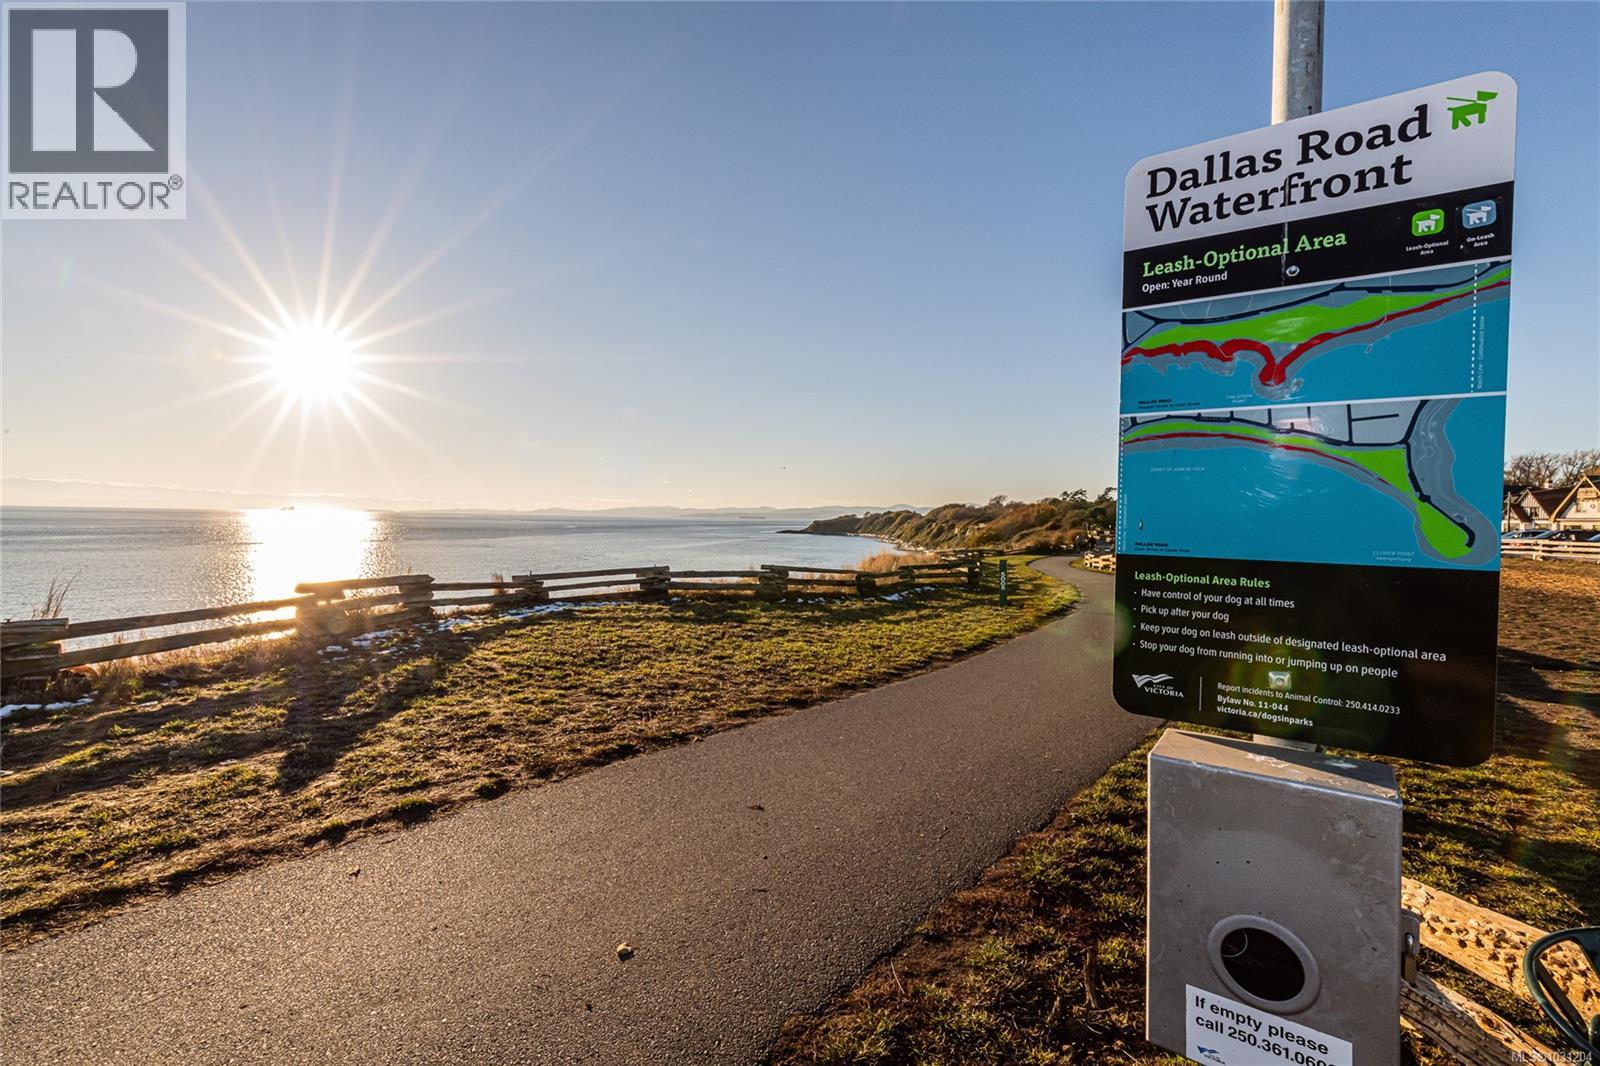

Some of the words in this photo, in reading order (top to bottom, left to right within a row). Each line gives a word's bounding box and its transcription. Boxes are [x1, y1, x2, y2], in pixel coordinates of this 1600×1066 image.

[1146, 147, 1282, 199] Dallas
[1297, 104, 1431, 166] Road
[1146, 154, 1413, 232] Waterfront
[1406, 240, 1449, 252] Leash-Optional
[1466, 232, 1495, 243] On-Leash
[1142, 238, 1289, 277] Leash-Optional
[1295, 231, 1348, 253] Area
[1142, 281, 1170, 294] Open:
[1172, 278, 1193, 288] Year
[1195, 271, 1228, 284] Round
[1134, 570, 1210, 585] Leash-Optional
[1212, 575, 1237, 587] Area
[1240, 578, 1270, 589] Rules
[1141, 588, 1162, 598] Have
[1162, 590, 1192, 600] control
[1193, 592, 1202, 600] of
[1204, 594, 1224, 604] your
[1224, 594, 1242, 606] dog
[1244, 597, 1253, 606] at
[1255, 597, 1266, 606] all
[1269, 598, 1295, 608] times
[1140, 604, 1157, 615] Pick
[1158, 607, 1169, 617] up
[1170, 608, 1190, 618] after
[1192, 610, 1211, 622] your
[1212, 611, 1230, 623] dog
[1140, 622, 1160, 634] Keep
[1161, 625, 1179, 636] your
[1181, 626, 1198, 638] dog
[1200, 629, 1210, 638] on
[1212, 629, 1236, 640] leash
[1238, 632, 1272, 644] outside
[1273, 636, 1284, 645] of
[1285, 636, 1339, 650] designated
[1342, 642, 1418, 659] leash-optional
[1420, 650, 1447, 662] area
[1140, 640, 1158, 651] Stop
[1159, 643, 1178, 654] your
[1179, 644, 1195, 656] dog
[1197, 646, 1217, 658] from
[1218, 650, 1253, 664] running
[1255, 652, 1273, 664] into
[1275, 656, 1285, 665] or
[1286, 656, 1328, 672] jumping
[1330, 662, 1343, 673] up
[1345, 663, 1358, 674] on
[1361, 666, 1398, 680] people
[1144, 686, 1184, 698] VICTORIA
[1217, 682, 1240, 693] Report
[1242, 686, 1274, 698] incidents
[1276, 690, 1284, 698] to
[1284, 692, 1311, 703] Animal
[1312, 695, 1344, 708] Control:
[1345, 700, 1401, 715] 250.414.0233
[1217, 694, 1241, 706] Bylaw
[1243, 699, 1256, 708] No.
[1258, 701, 1289, 712] 11-044
[1216, 705, 1314, 727] victoria.ca/dogsinparks
[1195, 996, 1206, 1009] If
[1210, 1004, 1262, 1032] empty
[1268, 1023, 1328, 1054] please
[1196, 1016, 1224, 1034] call
